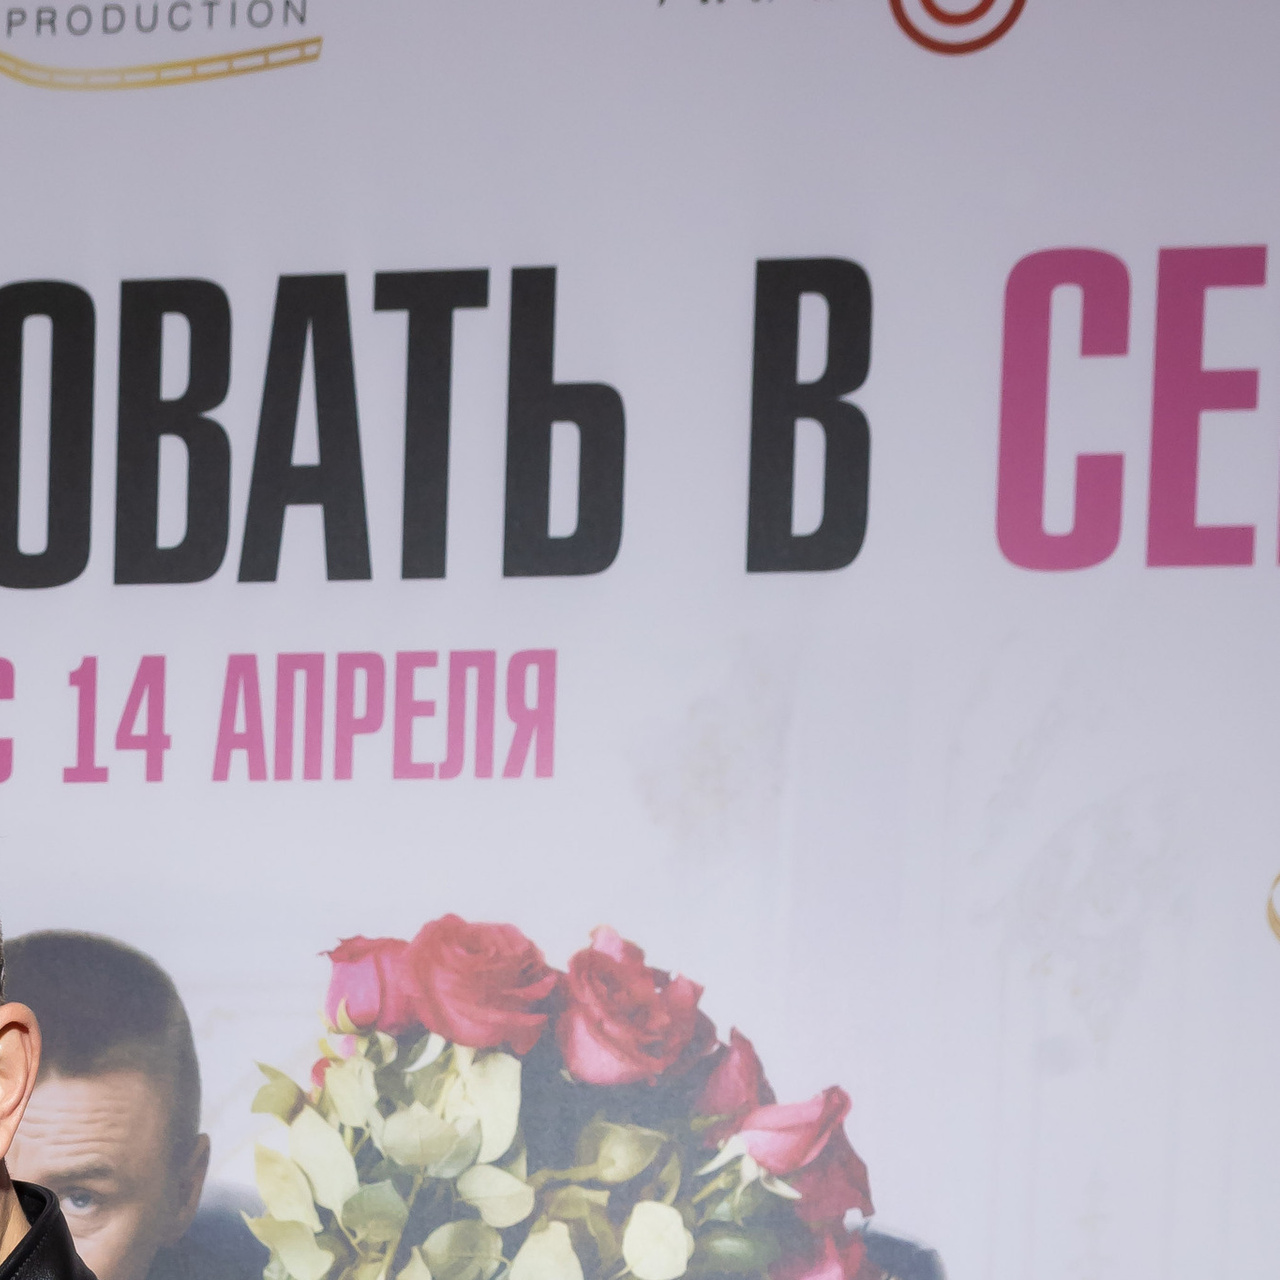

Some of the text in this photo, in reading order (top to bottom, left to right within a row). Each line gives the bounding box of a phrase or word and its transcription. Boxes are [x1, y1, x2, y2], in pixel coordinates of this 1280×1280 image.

[7, 0, 308, 37] PRODUCTION
[746, 256, 873, 574] В
[996, 244, 1280, 572] СЕ
[62, 655, 172, 783] 14
[212, 649, 558, 782] АПРЕЛЯ
